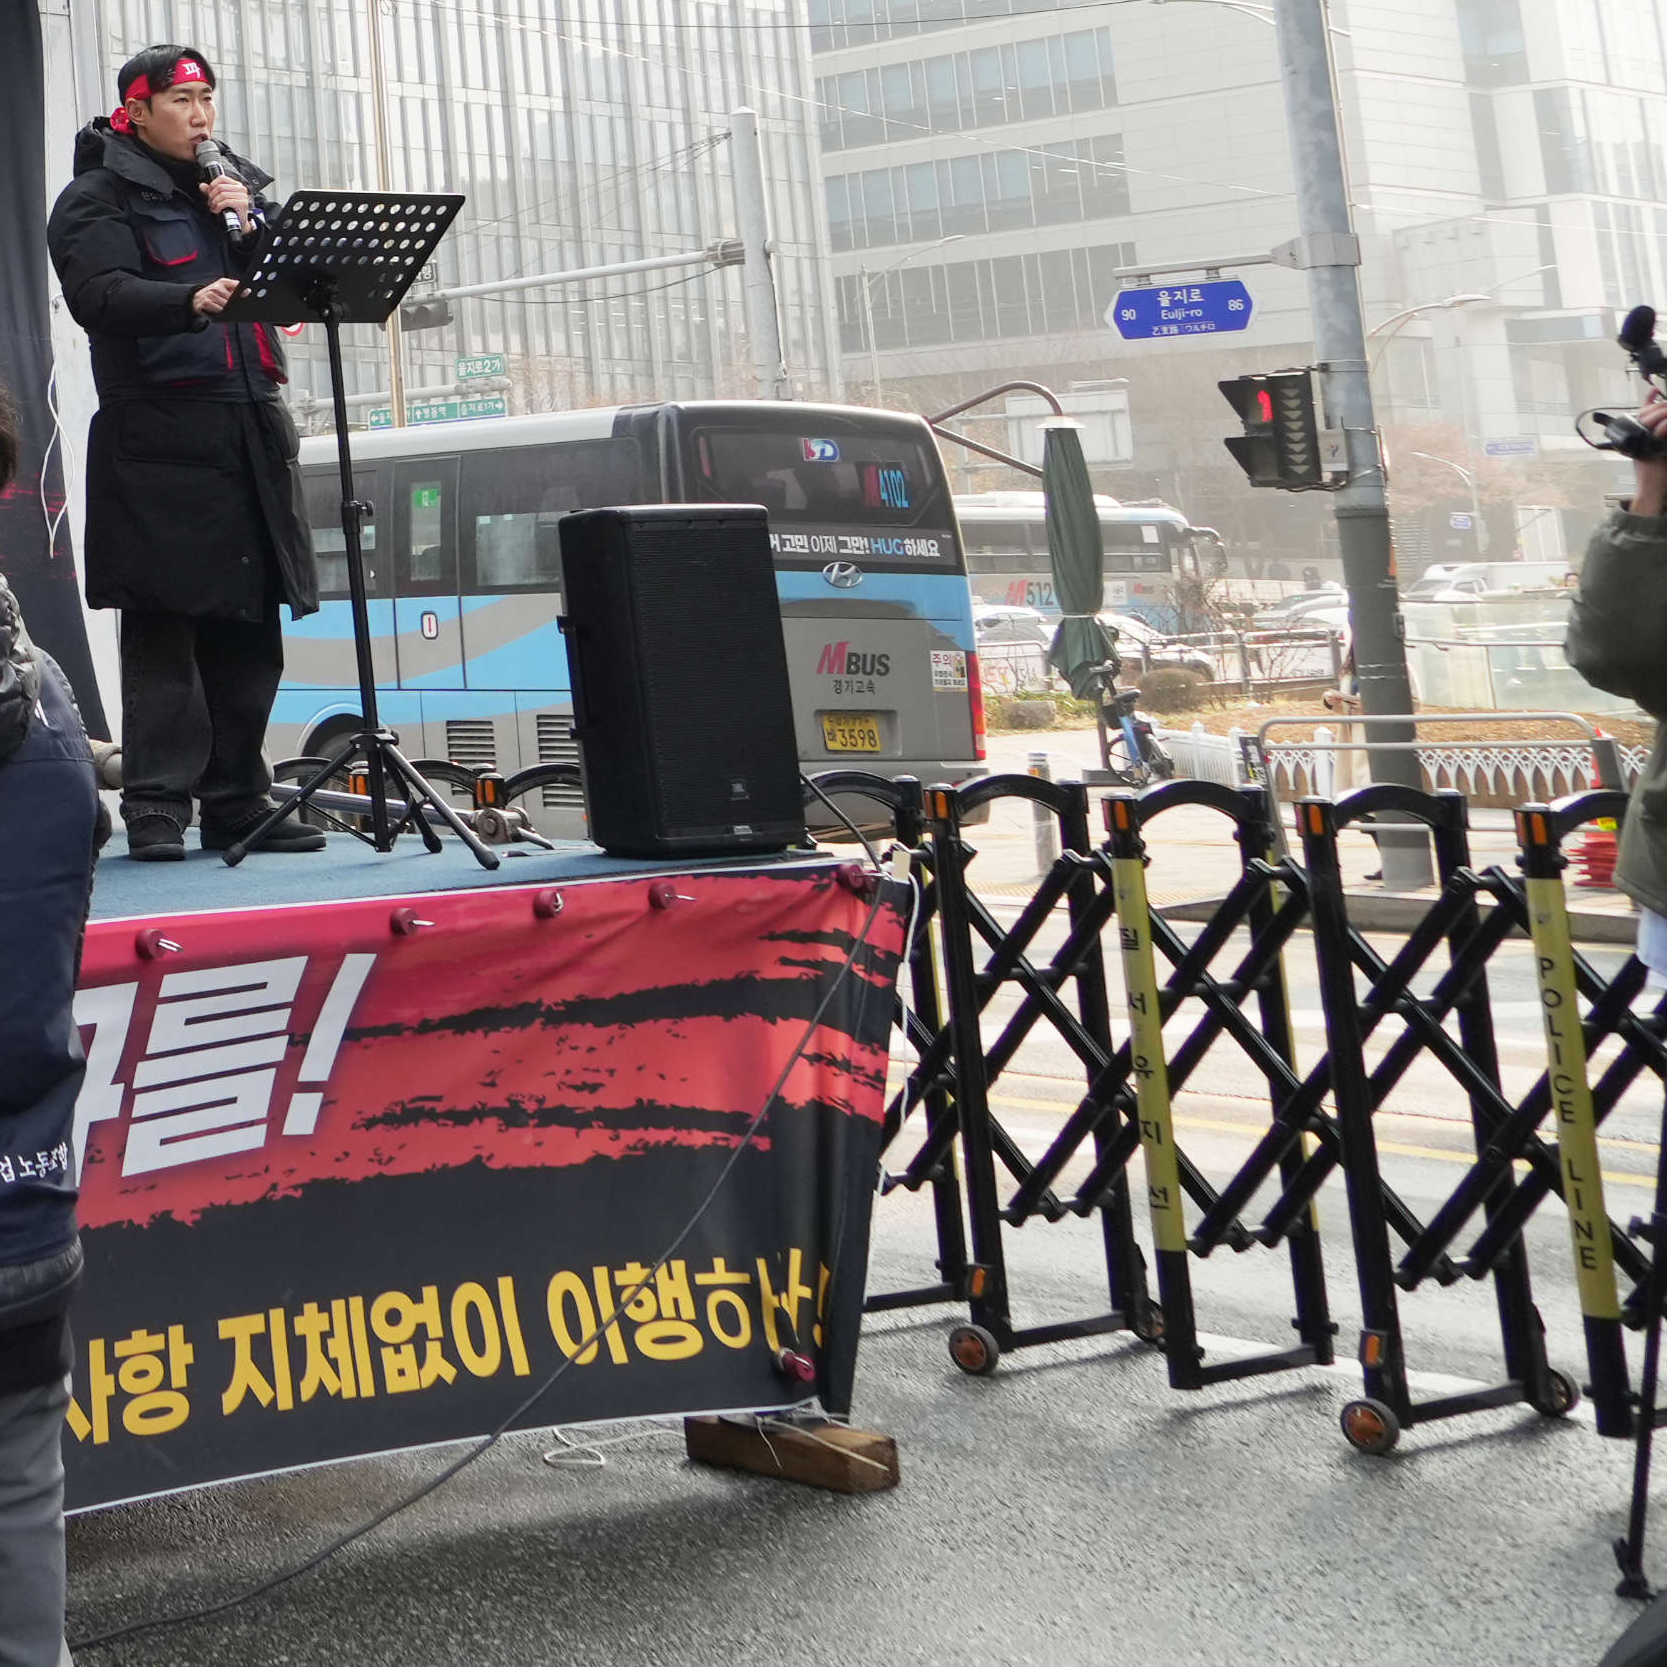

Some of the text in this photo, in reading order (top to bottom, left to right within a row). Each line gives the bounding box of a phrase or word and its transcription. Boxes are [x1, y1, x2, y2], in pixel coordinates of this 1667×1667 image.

[1157, 288, 1204, 307] 을지로
[1227, 298, 1244, 311] 86
[1121, 310, 1136, 321] 90
[1161, 308, 1203, 321] Eulji-ro
[457, 359, 502, 377] 을지로2가
[811, 535, 837, 553] 이제
[838, 536, 870, 555] 그만!
[1005, 579, 1054, 607] M512
[833, 679, 876, 694] 경기고속
[1537, 956, 1597, 1270] POLICE LINE
[220, 1276, 531, 1415] 지체없이
